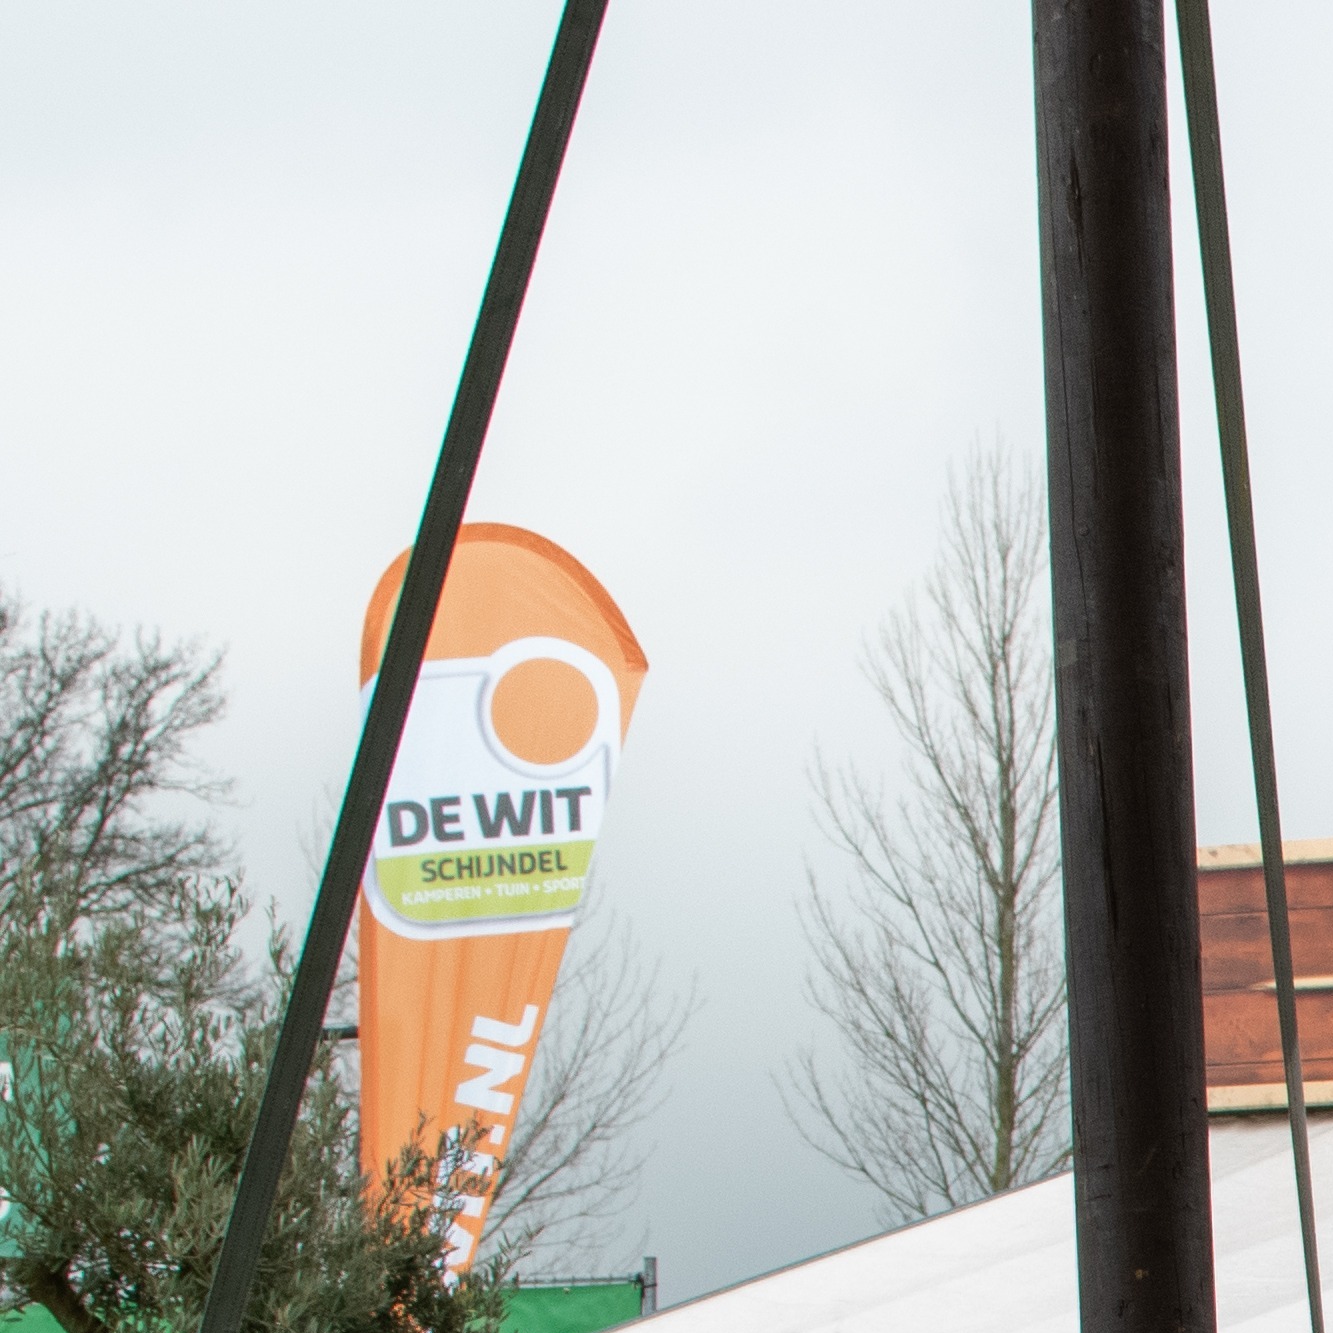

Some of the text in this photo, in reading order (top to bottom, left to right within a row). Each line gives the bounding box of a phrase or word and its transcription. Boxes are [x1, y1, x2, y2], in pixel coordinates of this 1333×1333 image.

[387, 785, 592, 848] DE WIT
[421, 850, 568, 883] SCHIJNDEL
[402, 886, 482, 906] KAMPEREN
[494, 881, 530, 896] TUIN
